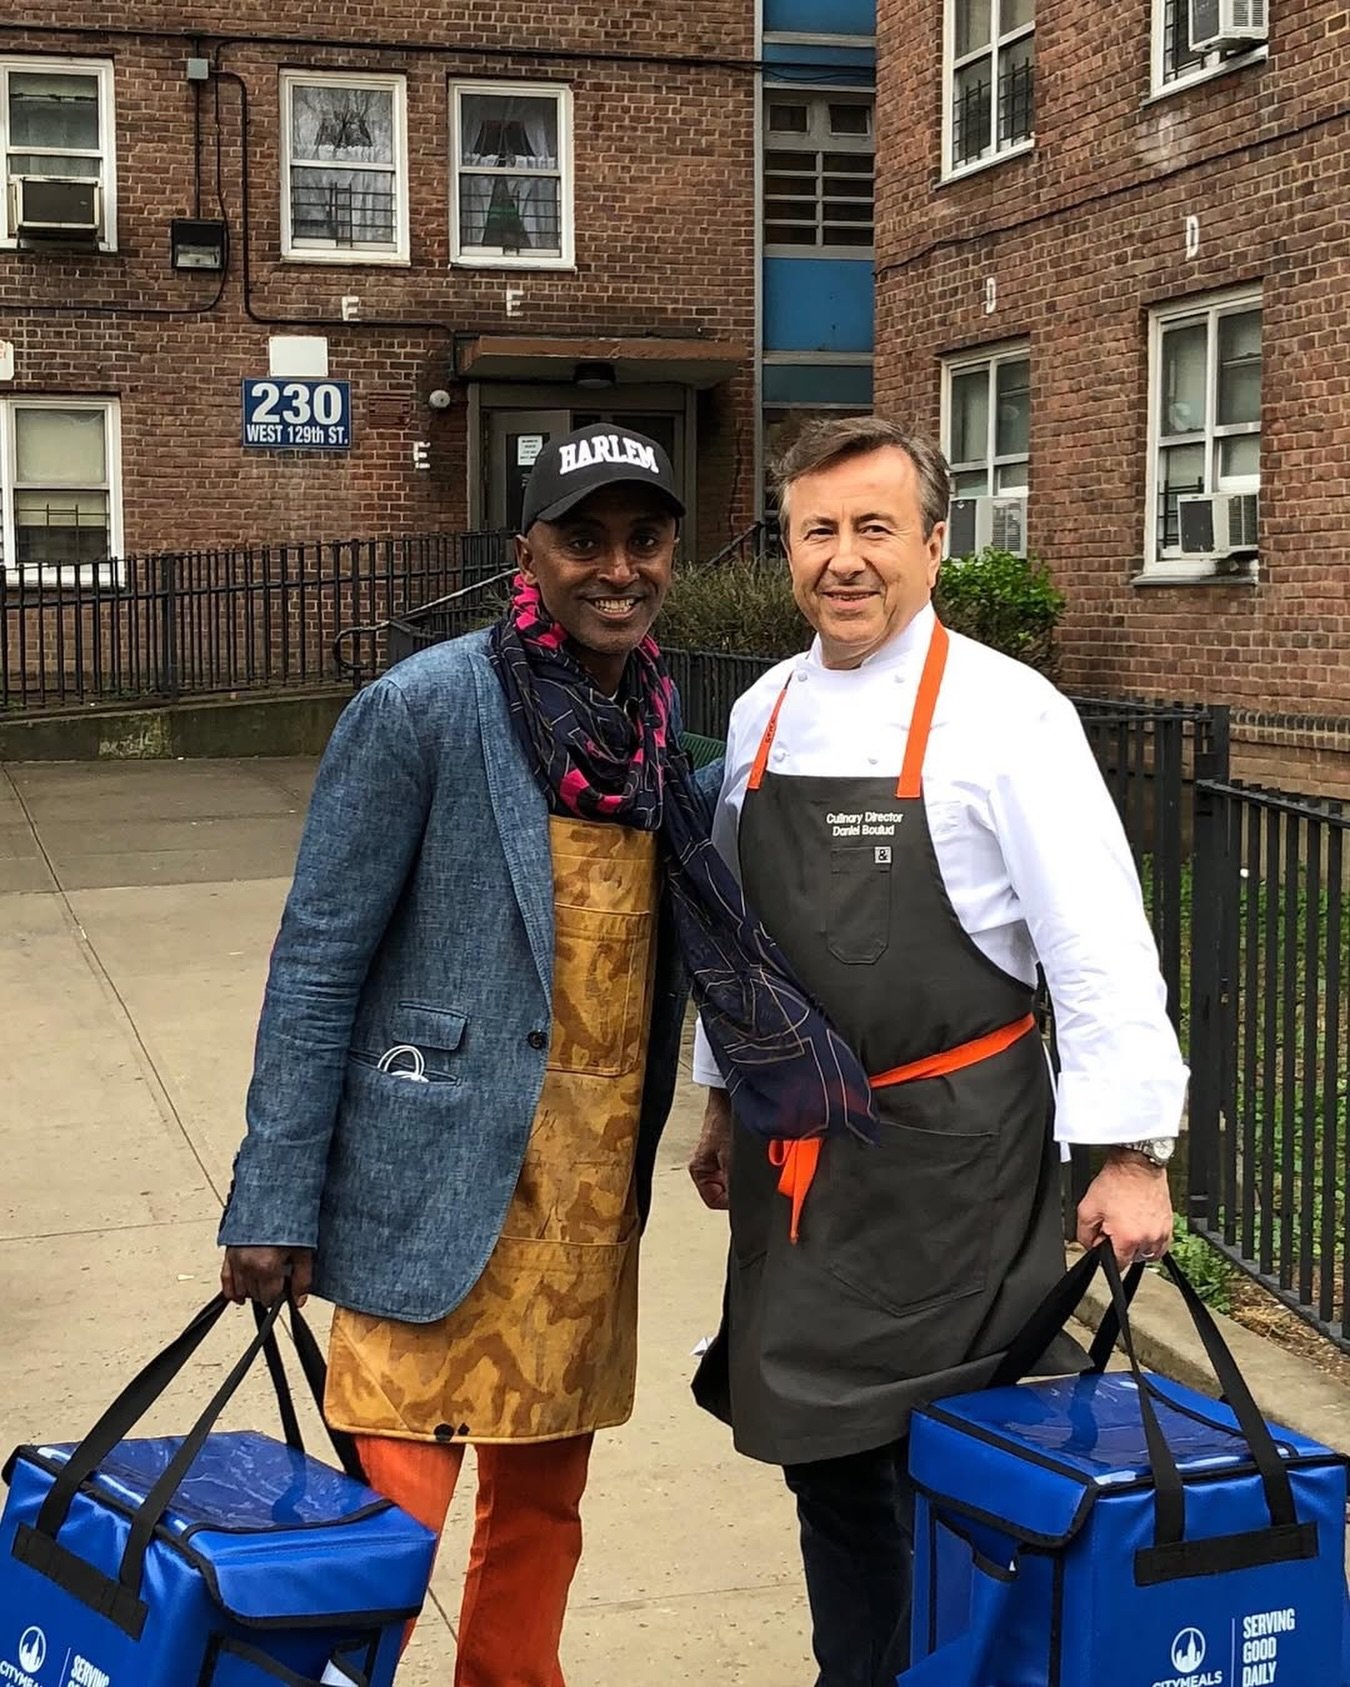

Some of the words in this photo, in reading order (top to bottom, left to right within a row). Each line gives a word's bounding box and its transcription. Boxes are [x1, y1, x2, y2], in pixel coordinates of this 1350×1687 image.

[341, 296, 360, 322] E
[506, 289, 524, 317] E
[251, 382, 343, 425] 230
[246, 424, 283, 443] WEST
[287, 425, 325, 444] 129th
[328, 426, 349, 445] ST.
[413, 441, 431, 469] E
[559, 434, 660, 475] HARLEM
[826, 813, 863, 825] Culinary
[864, 811, 904, 823] Director
[832, 825, 860, 837] Daniel
[1242, 1608, 1296, 1640] SERVING
[1242, 1637, 1277, 1665] GOOD
[0, 1660, 43, 1687] CITYME
[1241, 1660, 1278, 1687] DAILY
